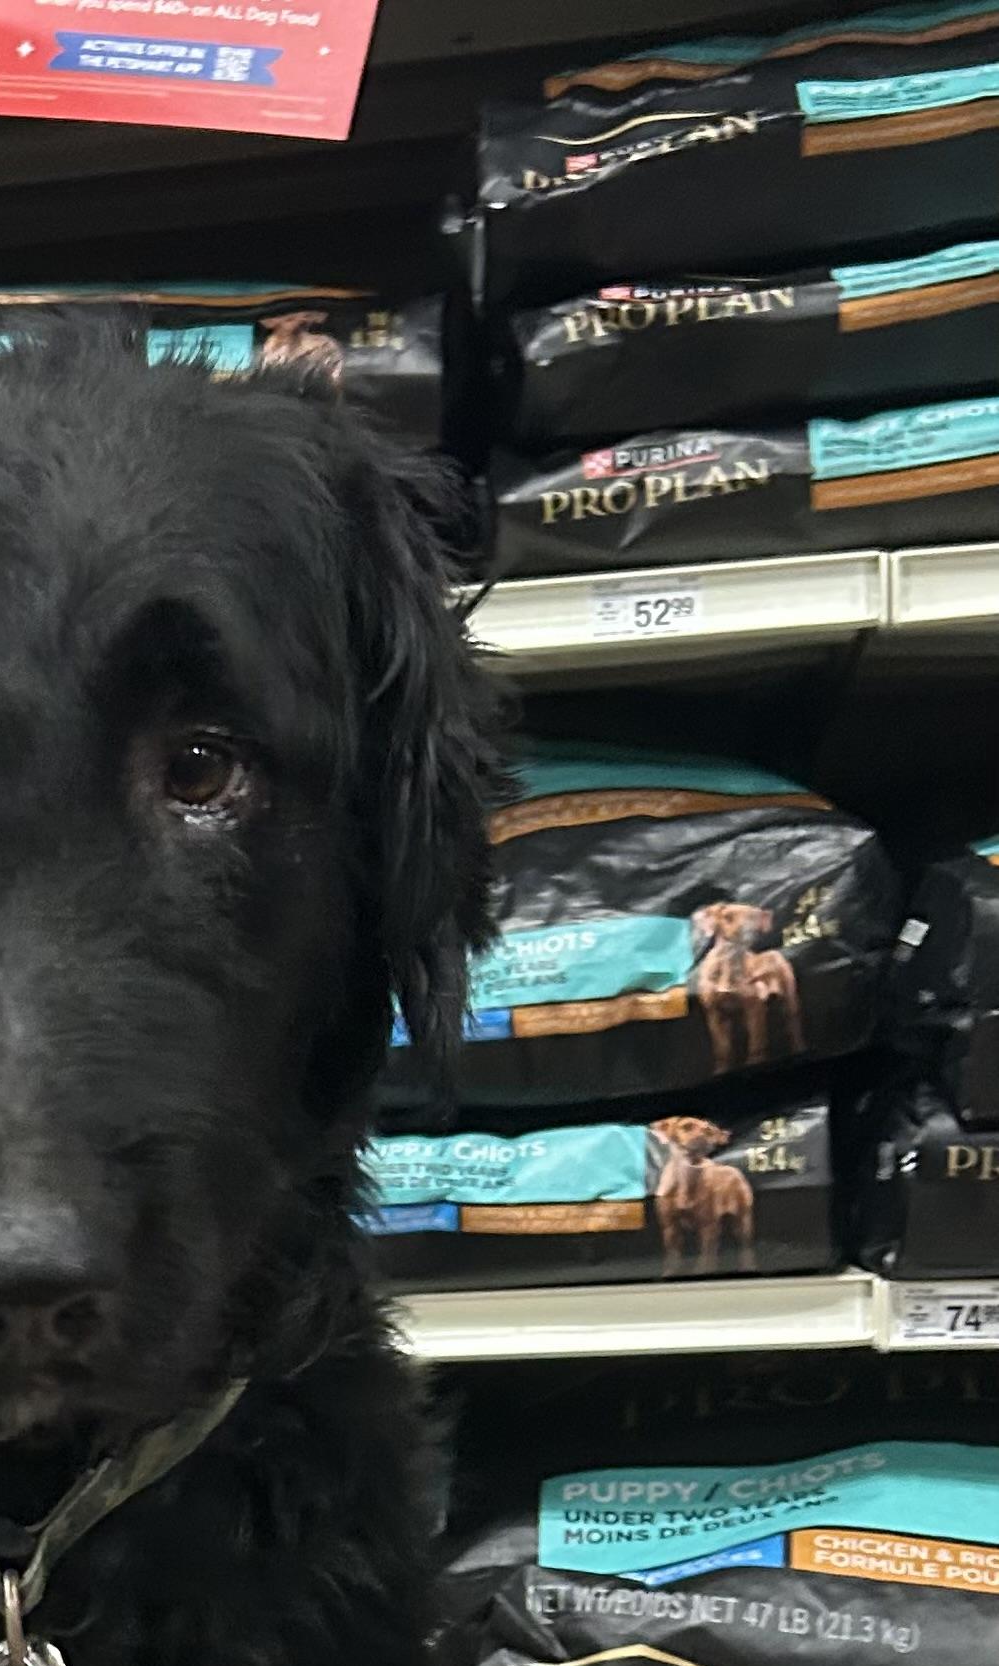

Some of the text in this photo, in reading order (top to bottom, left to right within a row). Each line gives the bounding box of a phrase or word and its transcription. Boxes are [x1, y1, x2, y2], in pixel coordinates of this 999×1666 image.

[214, 6, 242, 20] ALL
[245, 9, 278, 26] Dog
[280, 12, 321, 27] Food
[614, 439, 715, 468] PURINA
[760, 1117, 786, 1140] 34
[372, 1142, 434, 1159] UPPY
[454, 1140, 547, 1163] CHIOTS
[746, 1146, 787, 1171] 15.4
[562, 1452, 886, 1503] PUPPY / CHIOTS
[563, 1510, 655, 1526] UNDER
[663, 1507, 729, 1524] TWO
[563, 1528, 650, 1545] MOINS
[659, 1526, 697, 1540] DE
[703, 1511, 773, 1532] DEUX
[813, 1534, 999, 1569] CHICKEN & RIC
[813, 1550, 999, 1587] FORMULE POU
[526, 1585, 572, 1613] NET
[689, 1594, 739, 1624] NET
[742, 1602, 774, 1629] 47
[778, 1606, 810, 1635] LB
[816, 1611, 875, 1643] (21.3
[880, 1618, 921, 1654] kg)
